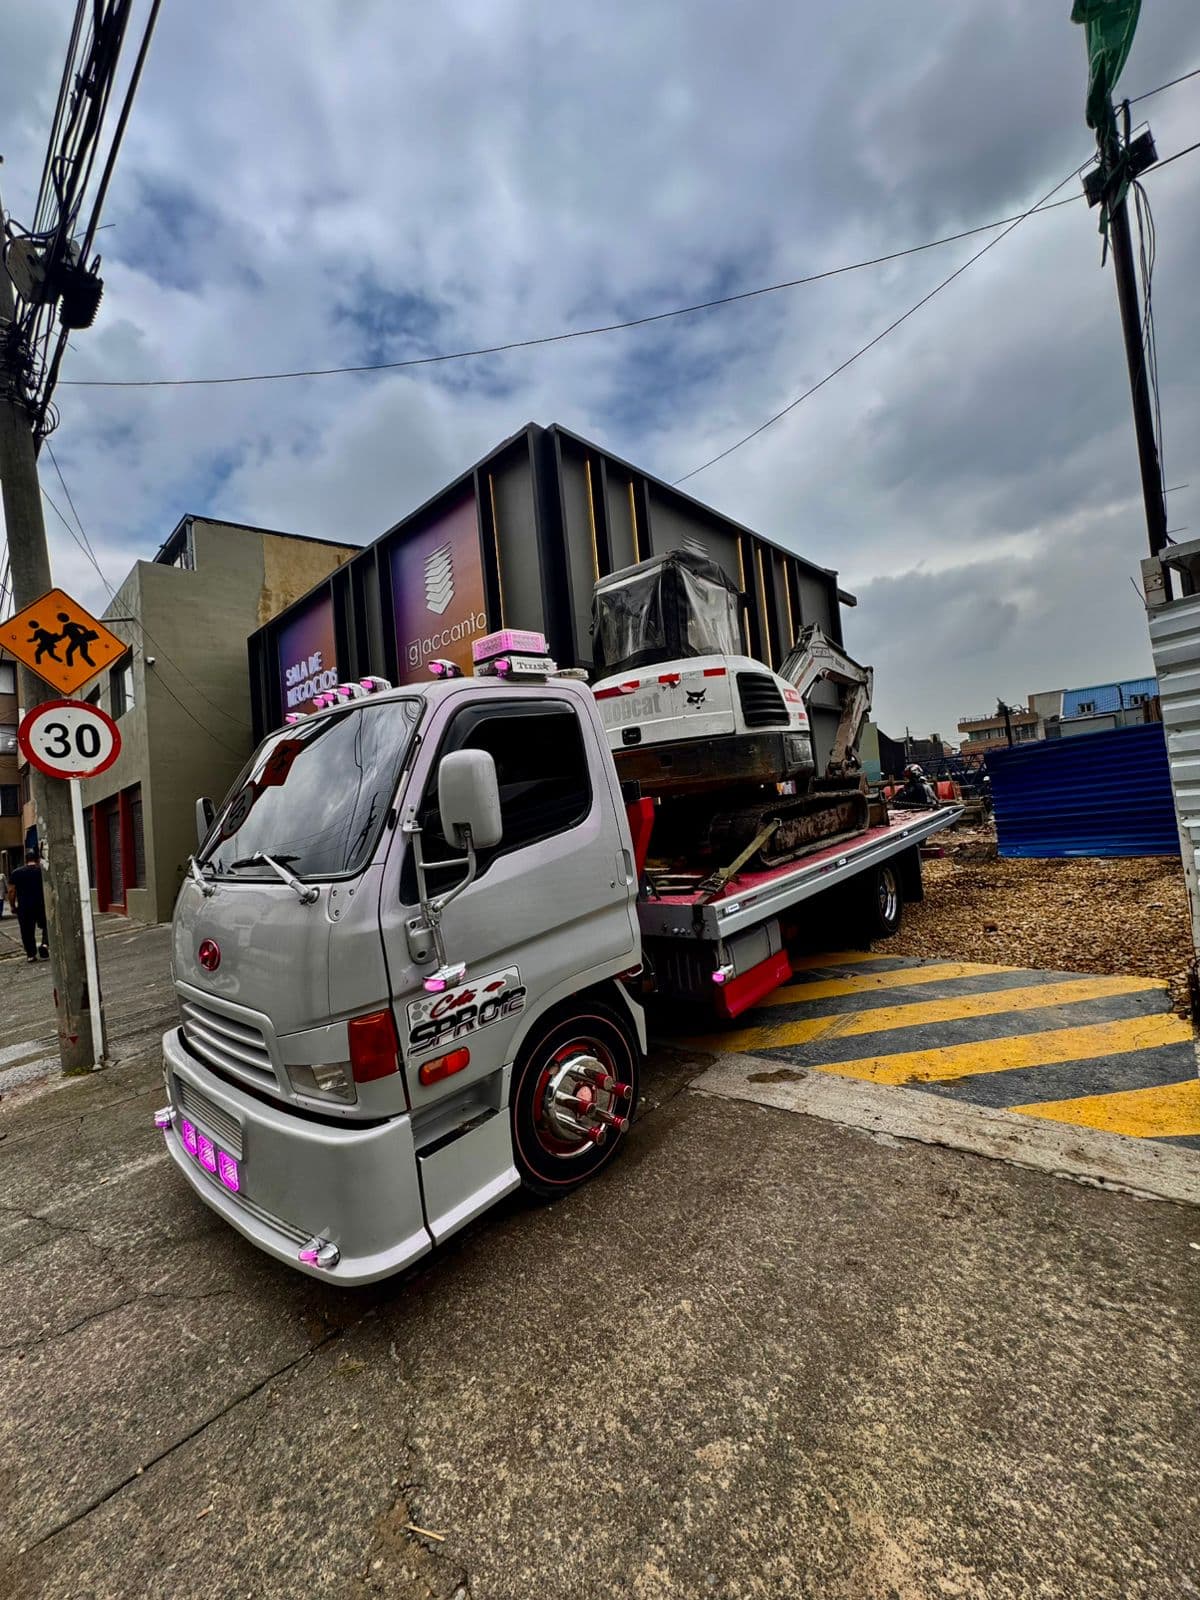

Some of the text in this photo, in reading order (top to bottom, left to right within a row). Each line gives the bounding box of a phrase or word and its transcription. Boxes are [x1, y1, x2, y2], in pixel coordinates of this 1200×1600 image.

[286, 651, 322, 686] SALA DE
[287, 667, 338, 708] NEGOCIOS
[44, 723, 101, 758] 30
